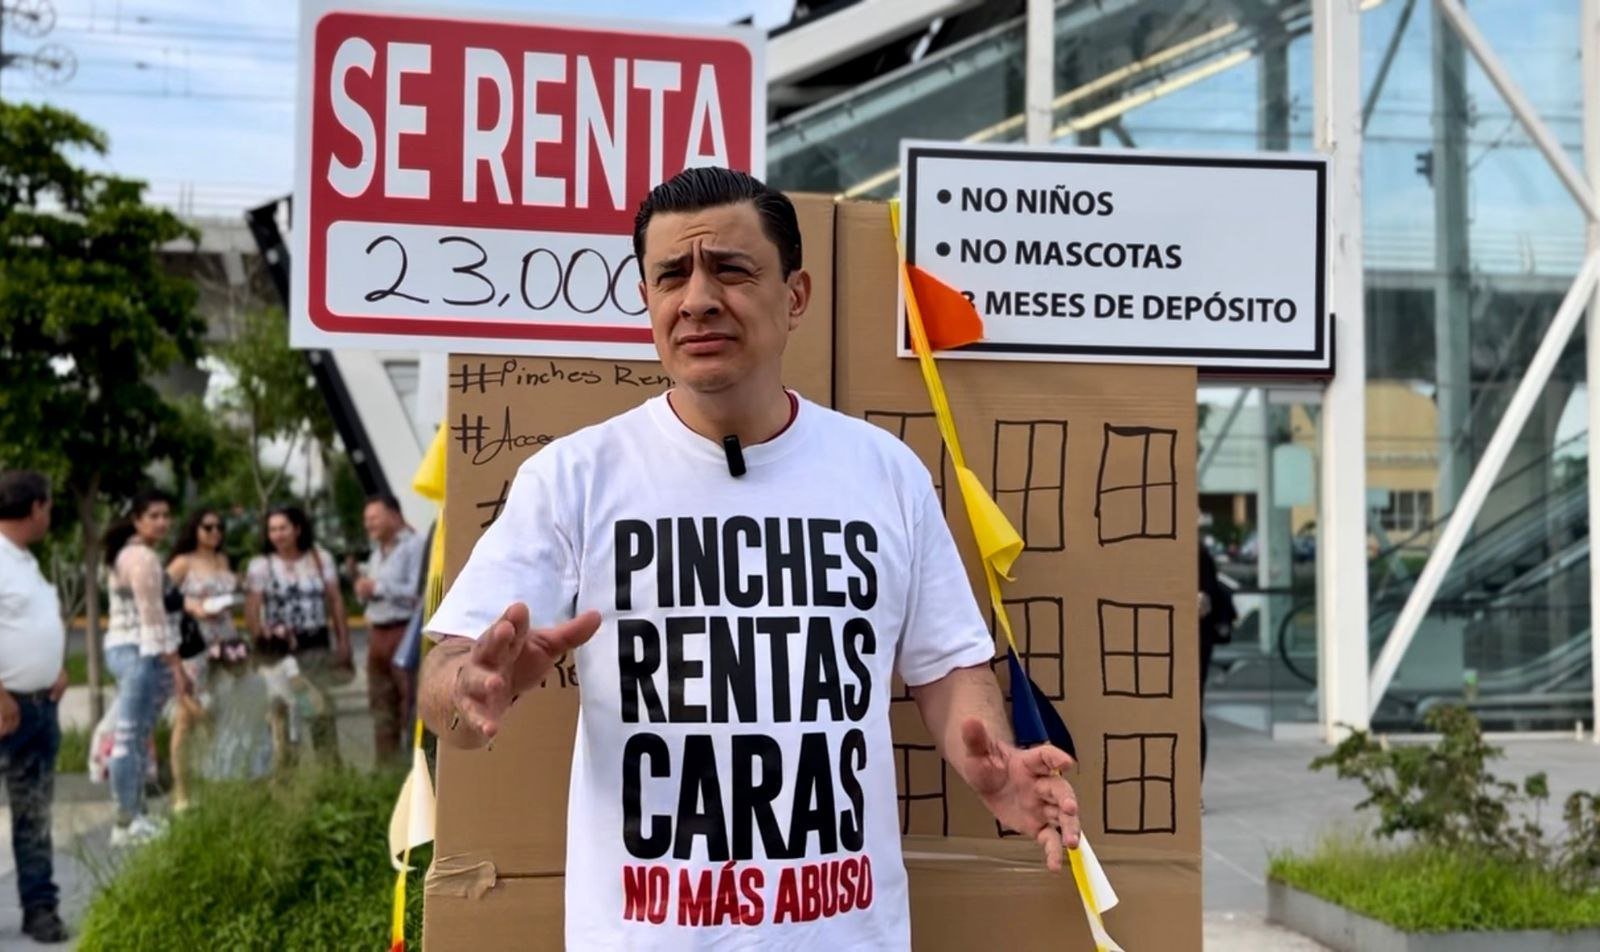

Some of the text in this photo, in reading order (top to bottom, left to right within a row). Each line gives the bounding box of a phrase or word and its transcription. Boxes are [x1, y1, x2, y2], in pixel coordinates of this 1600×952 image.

[327, 36, 730, 212] SE RENTA
[961, 185, 1114, 217] NO NIÑOS
[365, 235, 648, 315] 23,000
[960, 239, 1182, 270] NO MASCOTAS
[985, 291, 1086, 319] MESES
[1094, 294, 1134, 320] DE
[1143, 291, 1297, 323] DEPÓSITO
[449, 359, 676, 394] #Pinches Ren
[614, 515, 879, 611] PINCHES
[617, 616, 877, 724] RENTAS
[622, 728, 868, 862] CARAS
[623, 854, 874, 928] NO MÁS ABUSO
